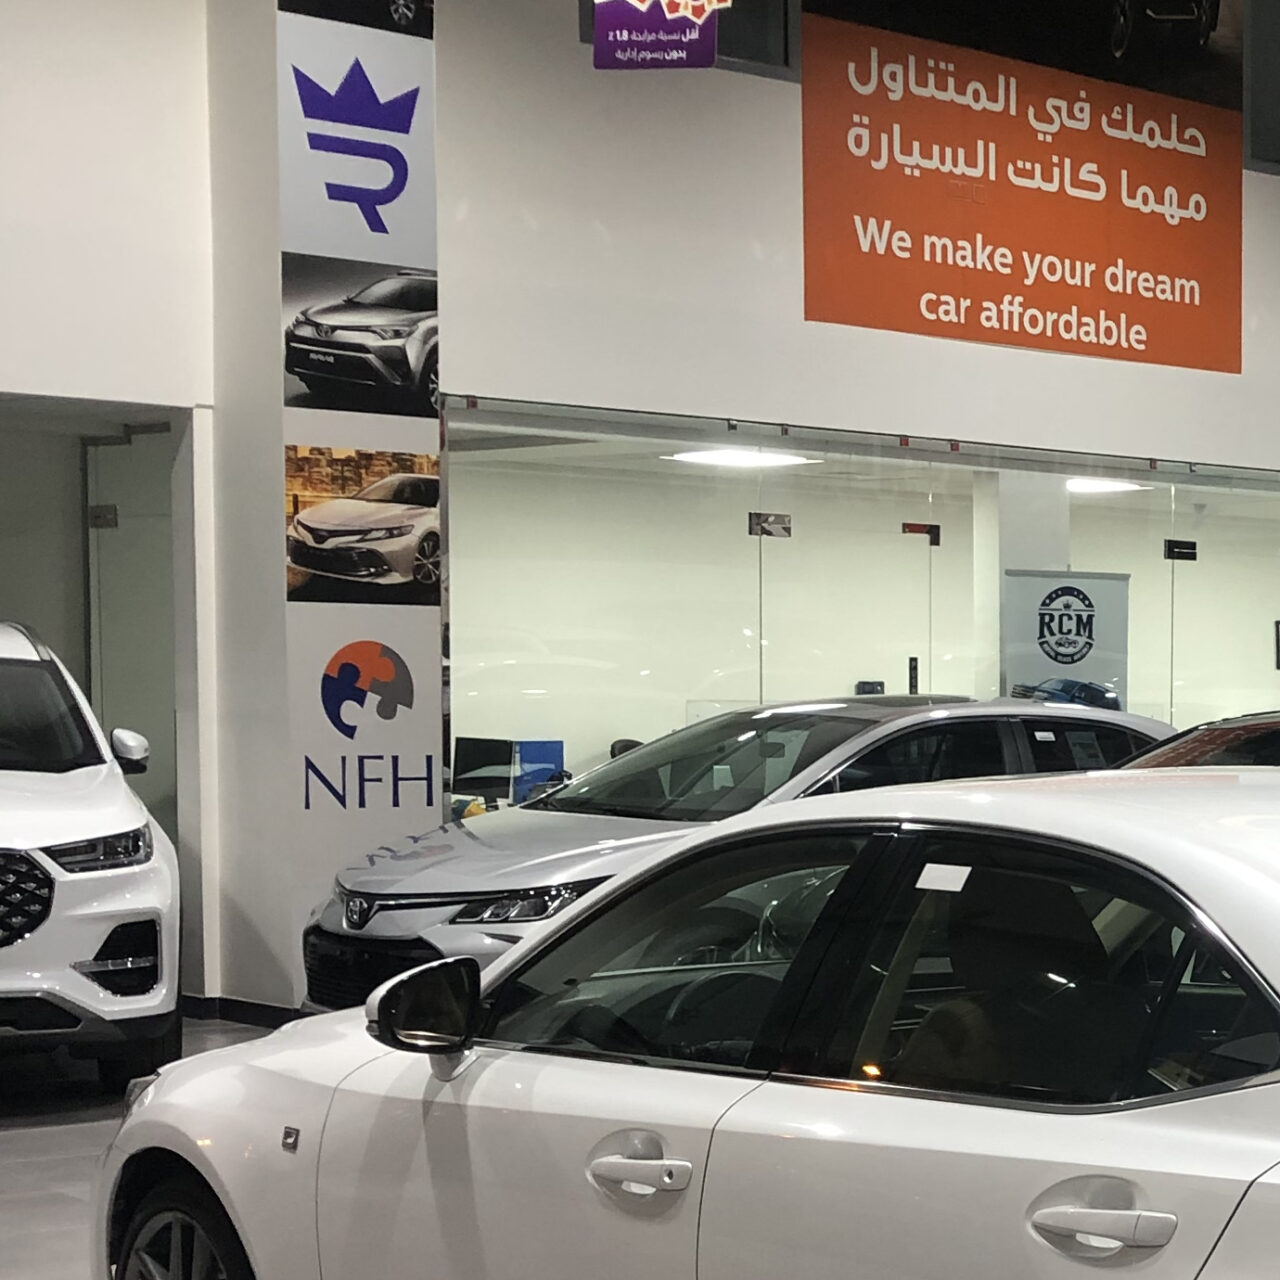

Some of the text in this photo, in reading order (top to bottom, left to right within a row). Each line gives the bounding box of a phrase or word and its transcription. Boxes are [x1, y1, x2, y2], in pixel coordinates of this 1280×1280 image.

[848, 47, 1207, 156] حلمك في المتناول
[847, 114, 1208, 226] مهما كانت السيارة
[853, 215, 1201, 305] We make your dream
[920, 292, 1148, 351] car affordable
[1037, 612, 1095, 641] RCM
[304, 753, 434, 810] NFH
